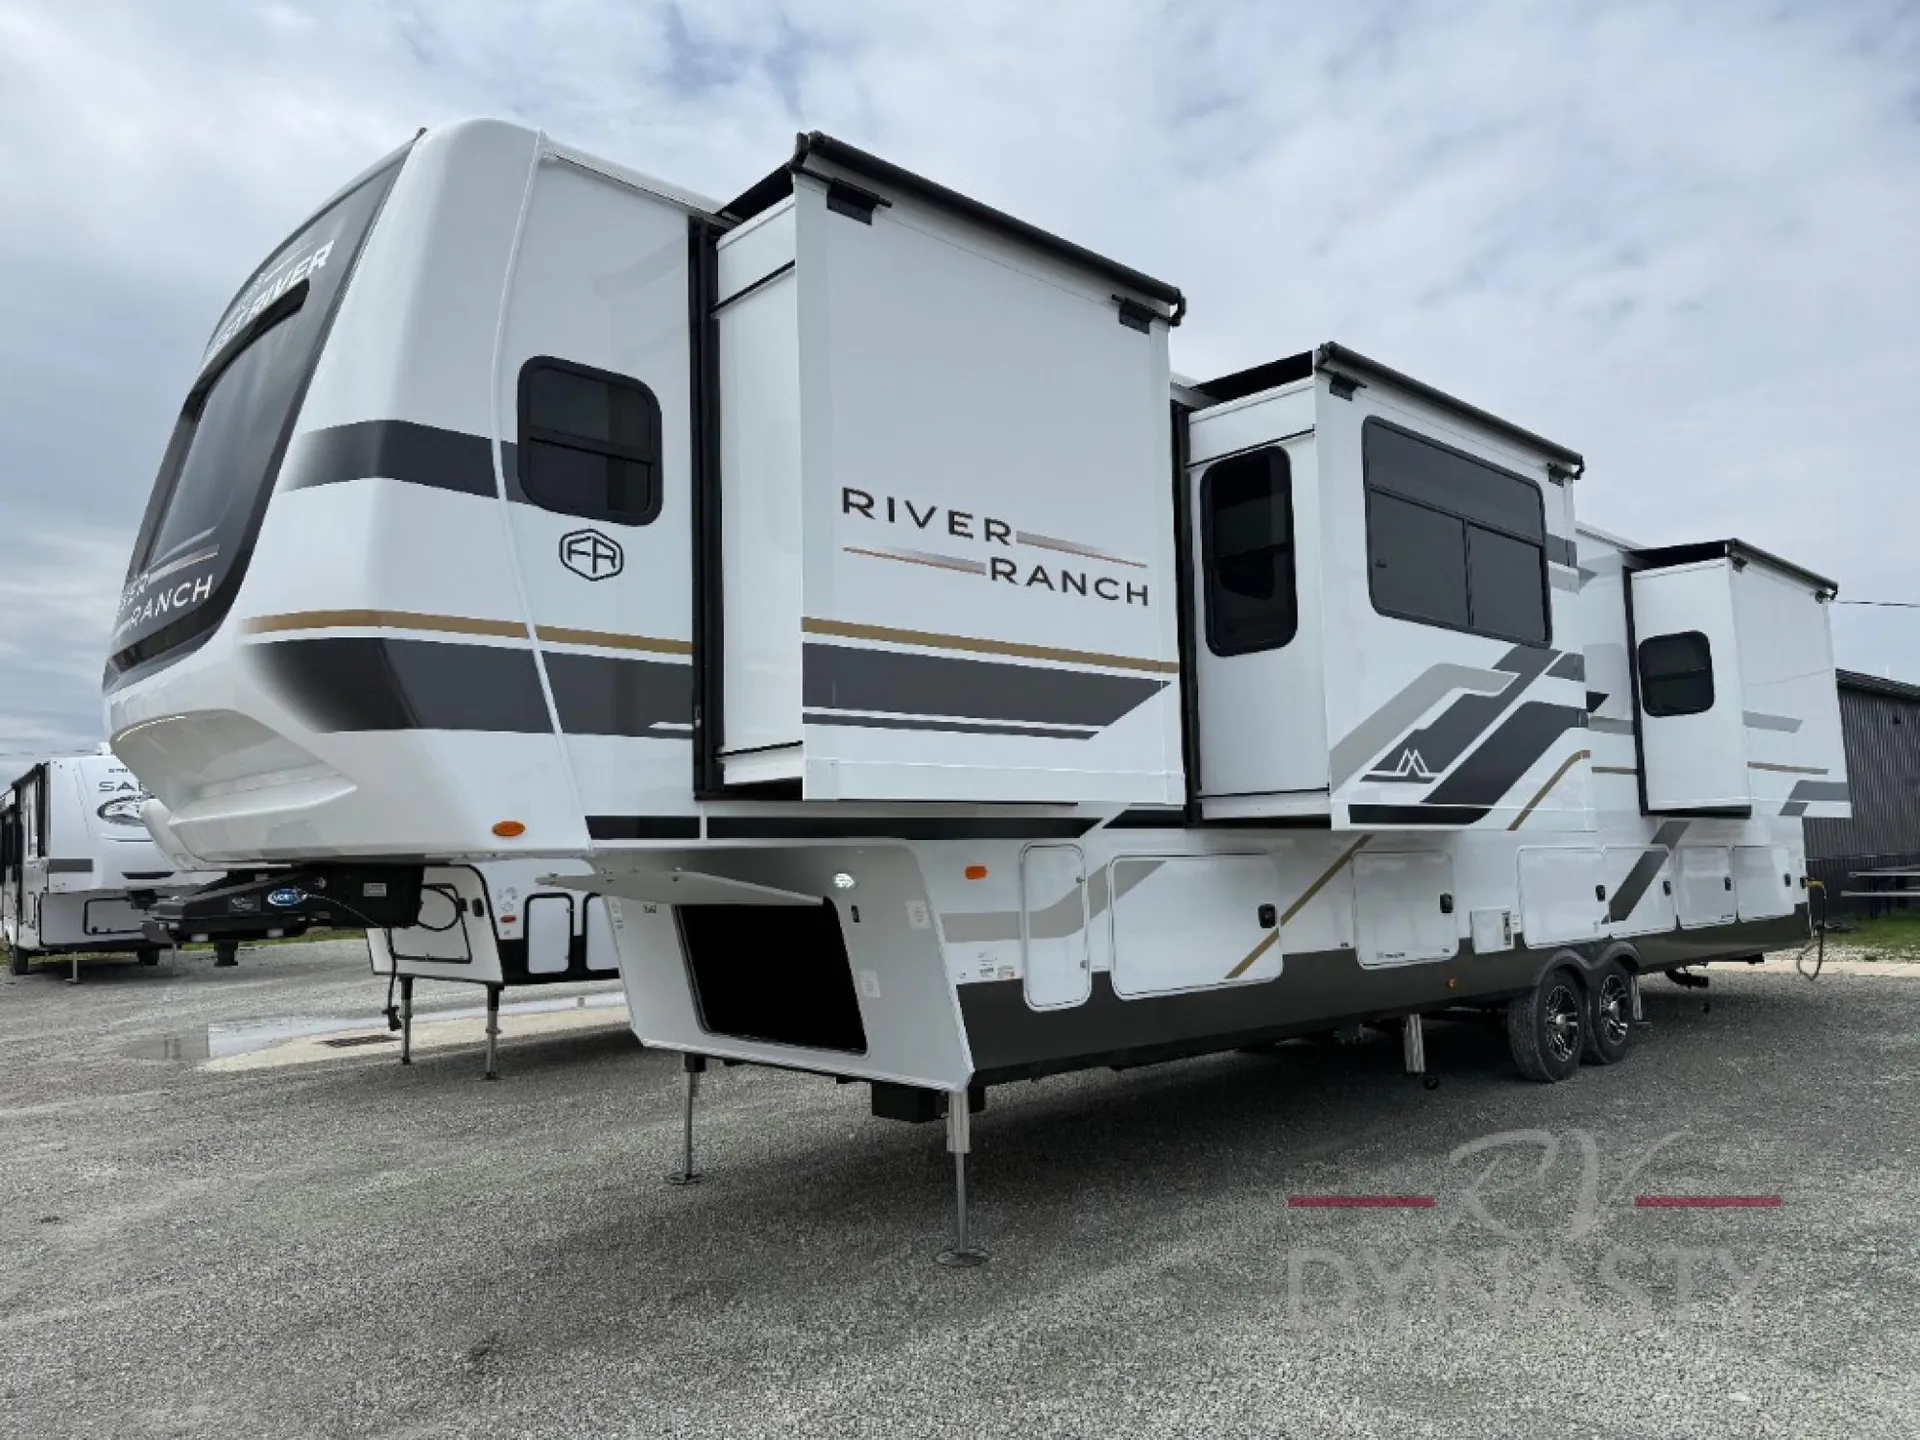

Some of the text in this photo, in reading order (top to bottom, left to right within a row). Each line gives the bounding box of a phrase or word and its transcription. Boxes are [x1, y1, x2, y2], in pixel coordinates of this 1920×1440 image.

[841, 486, 1012, 546] RIVER
[128, 573, 213, 631] RANCH
[990, 556, 1149, 607] RANCH
